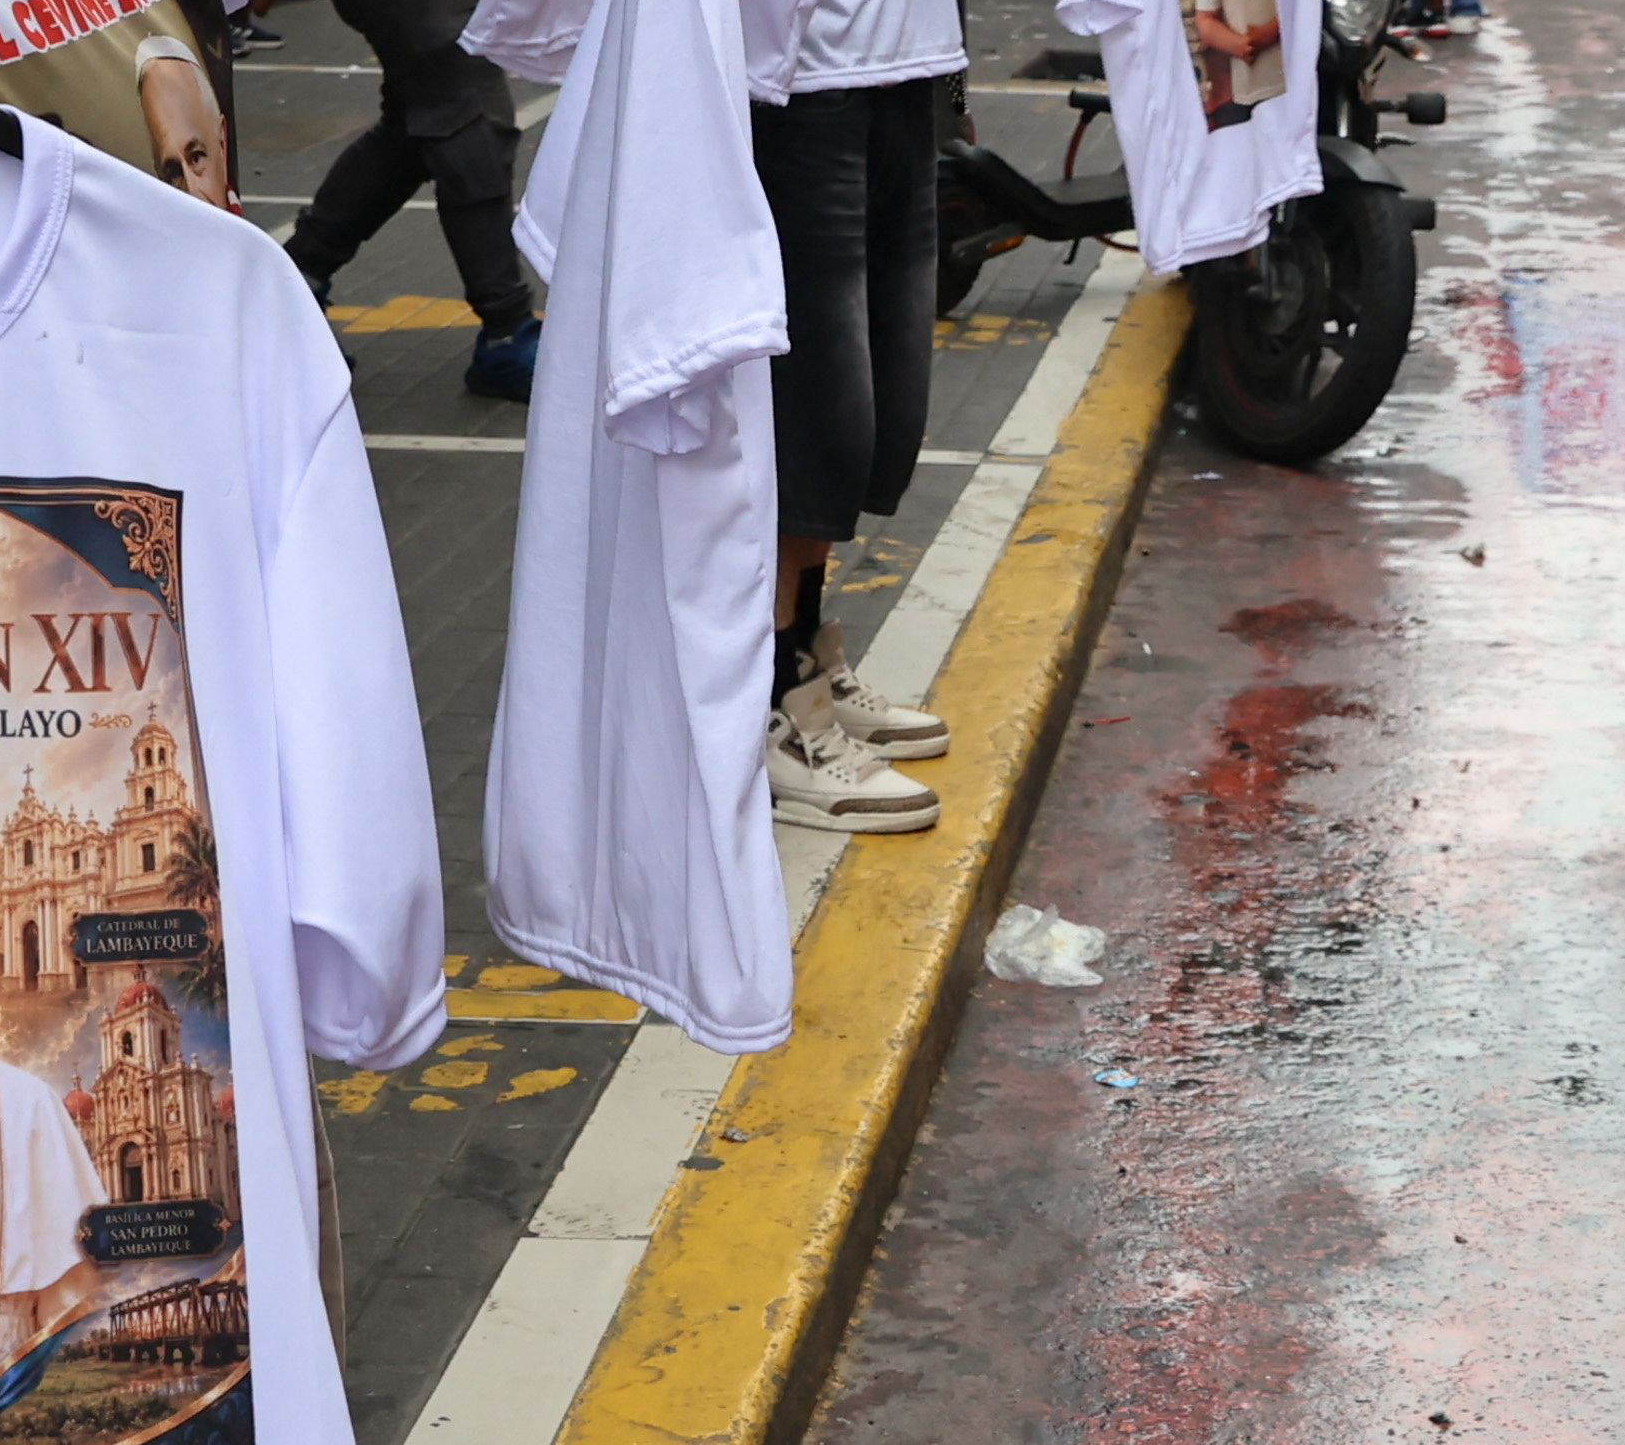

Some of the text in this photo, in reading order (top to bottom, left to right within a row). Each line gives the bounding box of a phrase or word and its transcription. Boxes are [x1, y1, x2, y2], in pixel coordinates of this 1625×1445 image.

[31, 611, 163, 694] XIV
[96, 918, 181, 933] CATEDRAL DE
[86, 933, 198, 954] LAMBAYEQUE
[110, 1224, 189, 1241] SAN PEDRO
[110, 1239, 192, 1256] LAMBAYEQUE
